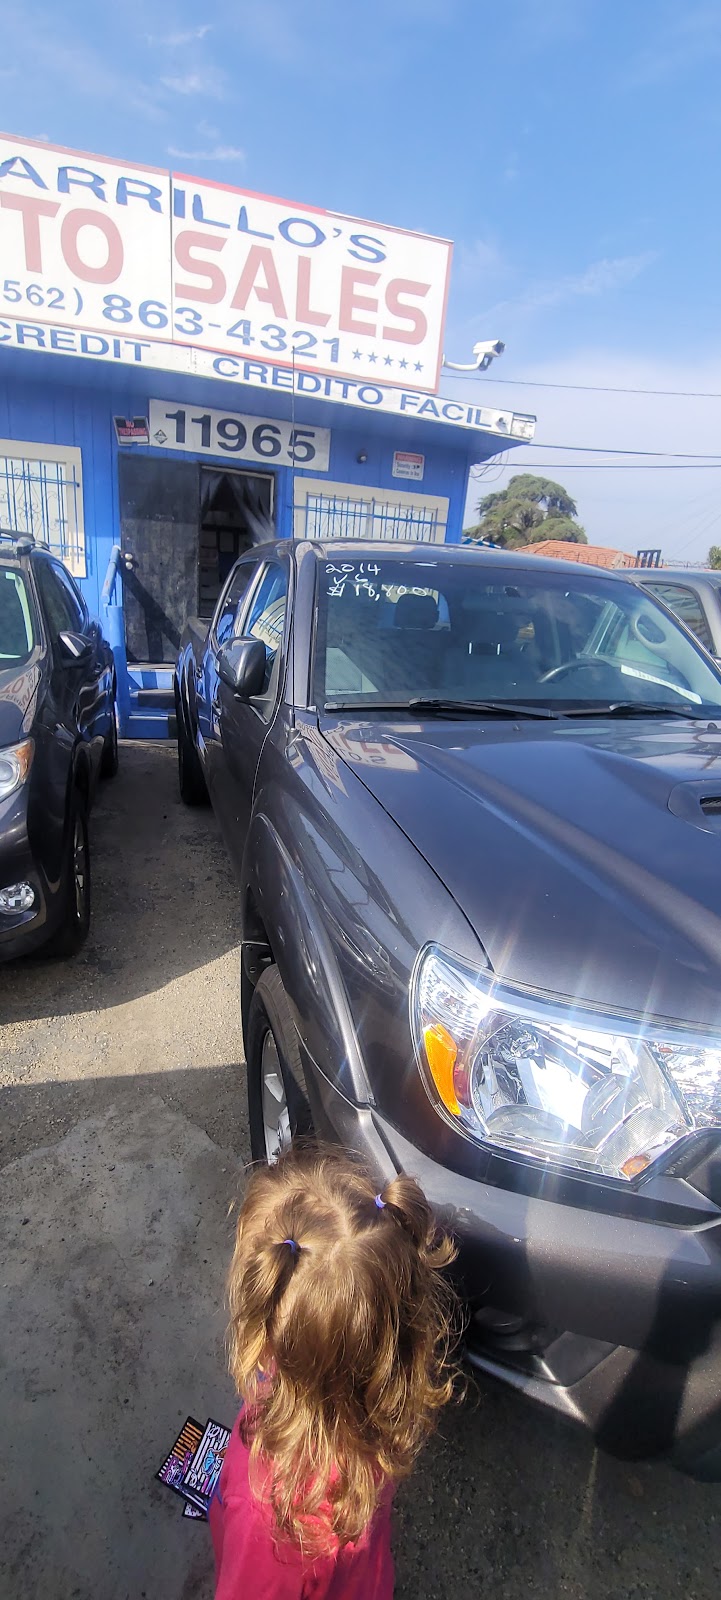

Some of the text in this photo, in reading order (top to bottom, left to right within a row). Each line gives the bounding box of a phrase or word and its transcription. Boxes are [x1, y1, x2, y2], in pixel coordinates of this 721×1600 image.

[0, 191, 432, 346] TO SALES
[102, 294, 340, 363] 863-4321
[212, 357, 492, 428] CREDITO FACIL
[165, 409, 316, 463] 11965
[325, 563, 381, 575] 2014
